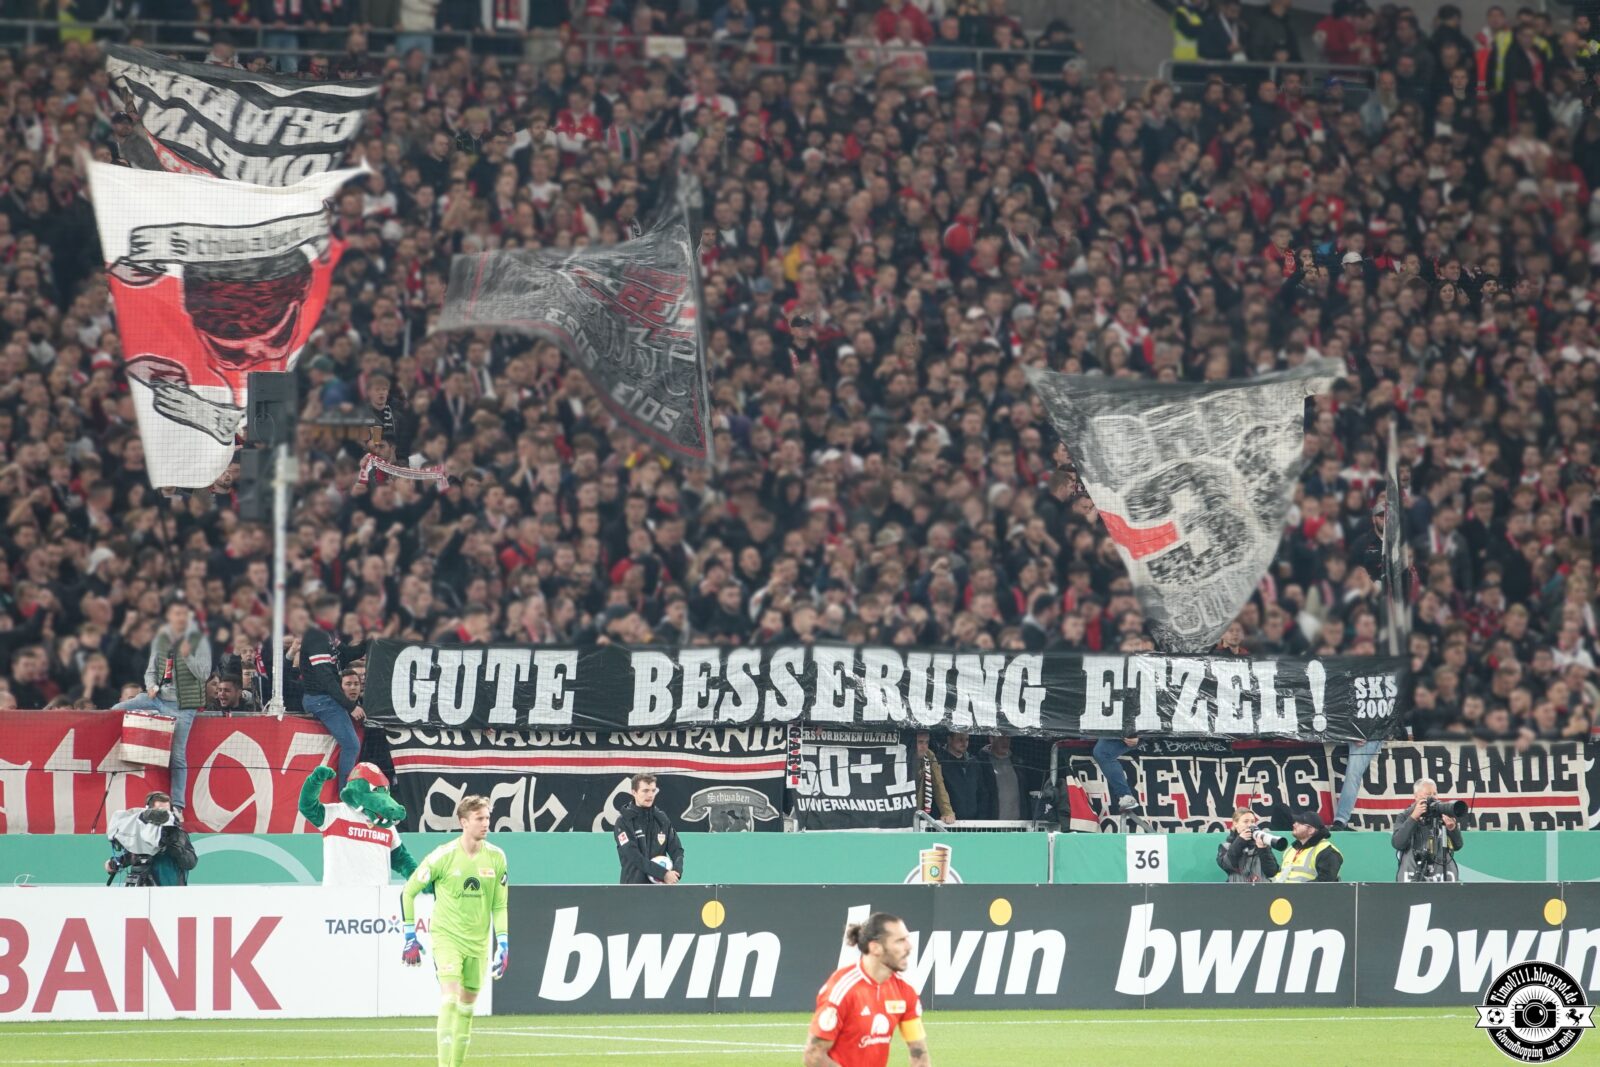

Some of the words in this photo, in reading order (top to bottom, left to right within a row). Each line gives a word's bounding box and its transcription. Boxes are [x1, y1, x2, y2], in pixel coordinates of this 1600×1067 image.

[391, 645, 578, 726] GUTE
[628, 645, 1047, 728] BESSERUNG
[1354, 675, 1398, 699] SKS
[800, 730, 862, 742] ERSTORBENEN
[863, 731, 898, 743] ULTRAS
[796, 743, 916, 797] 50+1
[707, 792, 750, 804] Schwaben
[348, 826, 390, 843] STUTTGART
[1134, 850, 1160, 869] 36
[538, 900, 781, 1001] bwin
[837, 898, 1067, 996] win
[1115, 898, 1346, 995] bwin
